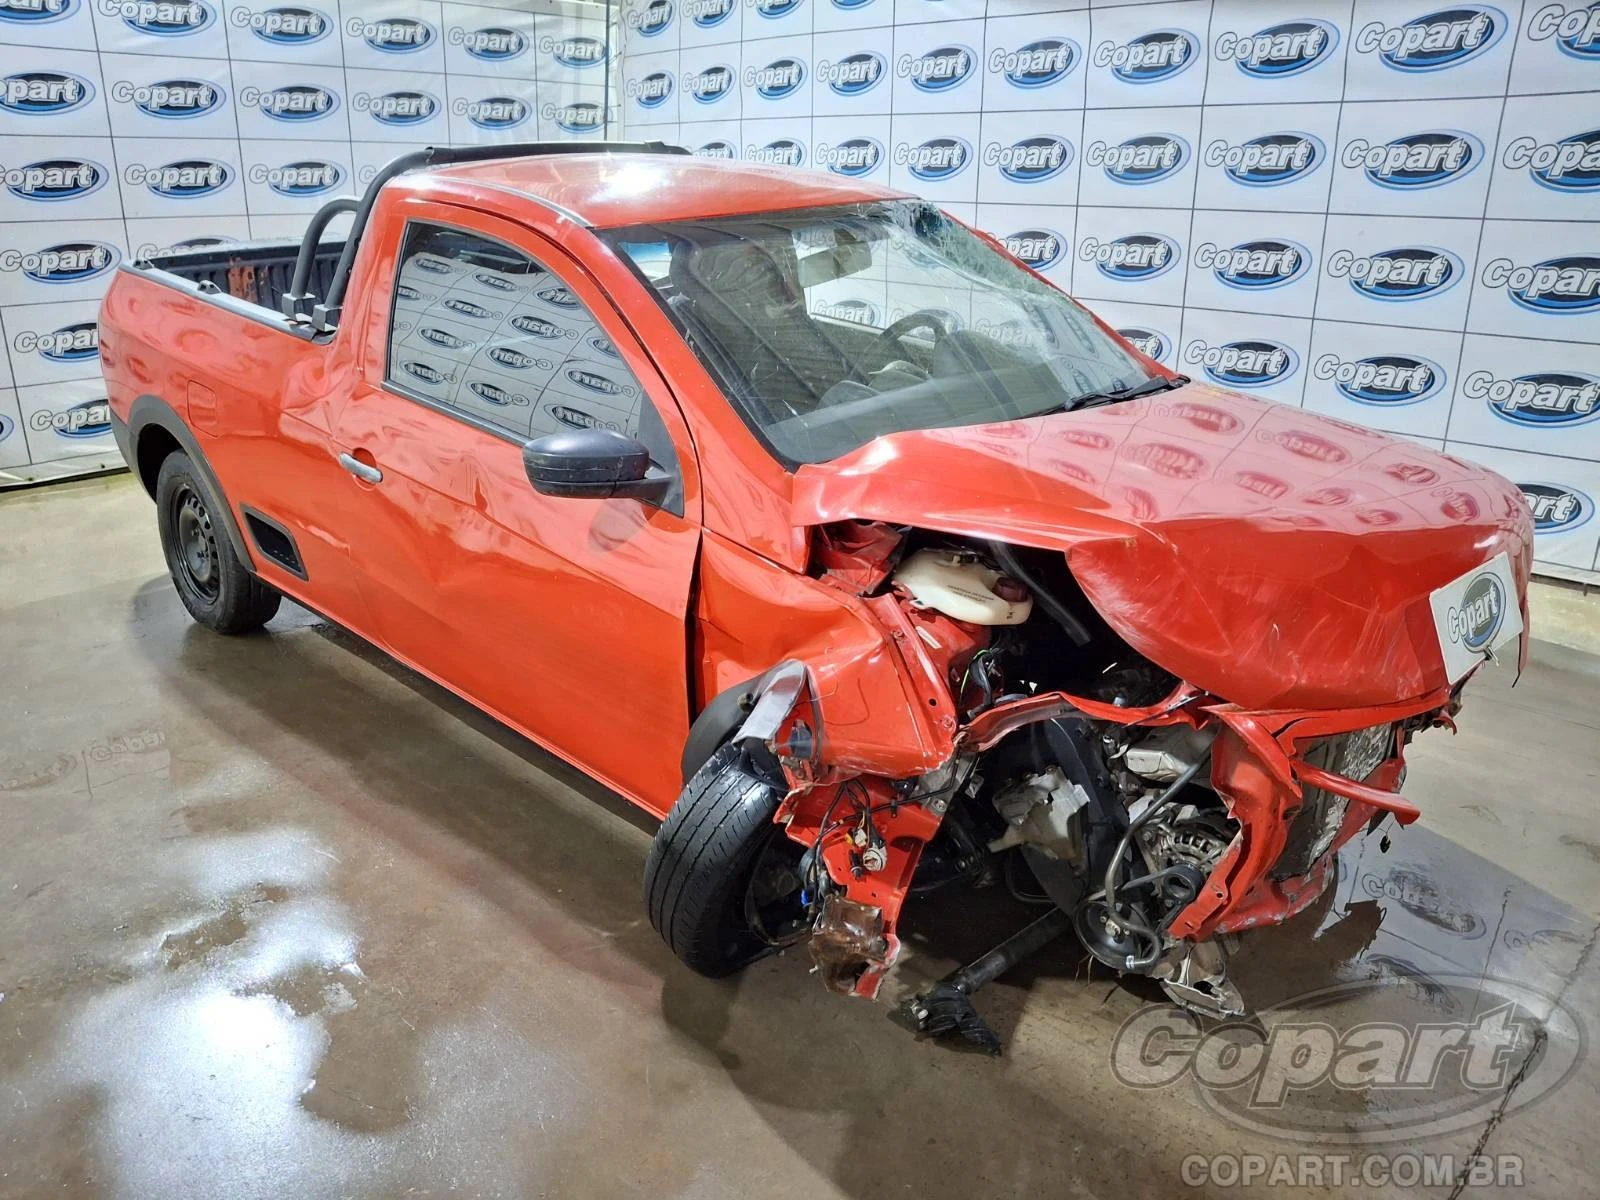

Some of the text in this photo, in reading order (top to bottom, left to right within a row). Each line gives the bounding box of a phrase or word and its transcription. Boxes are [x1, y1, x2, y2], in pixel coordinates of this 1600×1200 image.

[98, 0, 201, 25] Copart
[231, 7, 325, 35] Copart
[628, 1, 669, 29] Copart
[346, 17, 427, 45] Copart
[448, 25, 518, 51] Copart
[1355, 12, 1489, 60] Copart
[538, 35, 602, 59] Copart
[1094, 35, 1188, 73] Copart
[1215, 26, 1325, 67] Copart
[816, 55, 879, 85] Copart
[897, 49, 967, 82] Copart
[989, 43, 1071, 80] Copart
[0, 79, 79, 104] part
[626, 78, 668, 100] Copart
[682, 70, 728, 93] Copart
[744, 63, 801, 91] Copart
[112, 81, 213, 110] Copart
[240, 86, 327, 114] Copart
[352, 92, 431, 119] Copart
[452, 98, 521, 121] Copart
[542, 103, 603, 124] Copart
[815, 142, 877, 168] Copart
[894, 141, 965, 169] Copart
[984, 140, 1066, 170] Copart
[1086, 140, 1178, 173] Copart
[1205, 138, 1313, 175] Copart
[1341, 137, 1467, 179] Copart
[1503, 136, 1600, 179] Copa
[0, 163, 93, 192] opart
[124, 163, 221, 192] Copart
[250, 163, 335, 190] Copart
[0, 245, 106, 276] Copart
[1079, 236, 1169, 267] Copart
[1194, 242, 1298, 278] Copart
[1327, 249, 1449, 287] Copart
[1482, 258, 1600, 299] Copar
[1185, 340, 1286, 376] Copart
[1314, 353, 1431, 392] Copart
[1463, 370, 1600, 414] Copart
[30, 405, 111, 432] Copa
[1447, 580, 1500, 644] Copart
